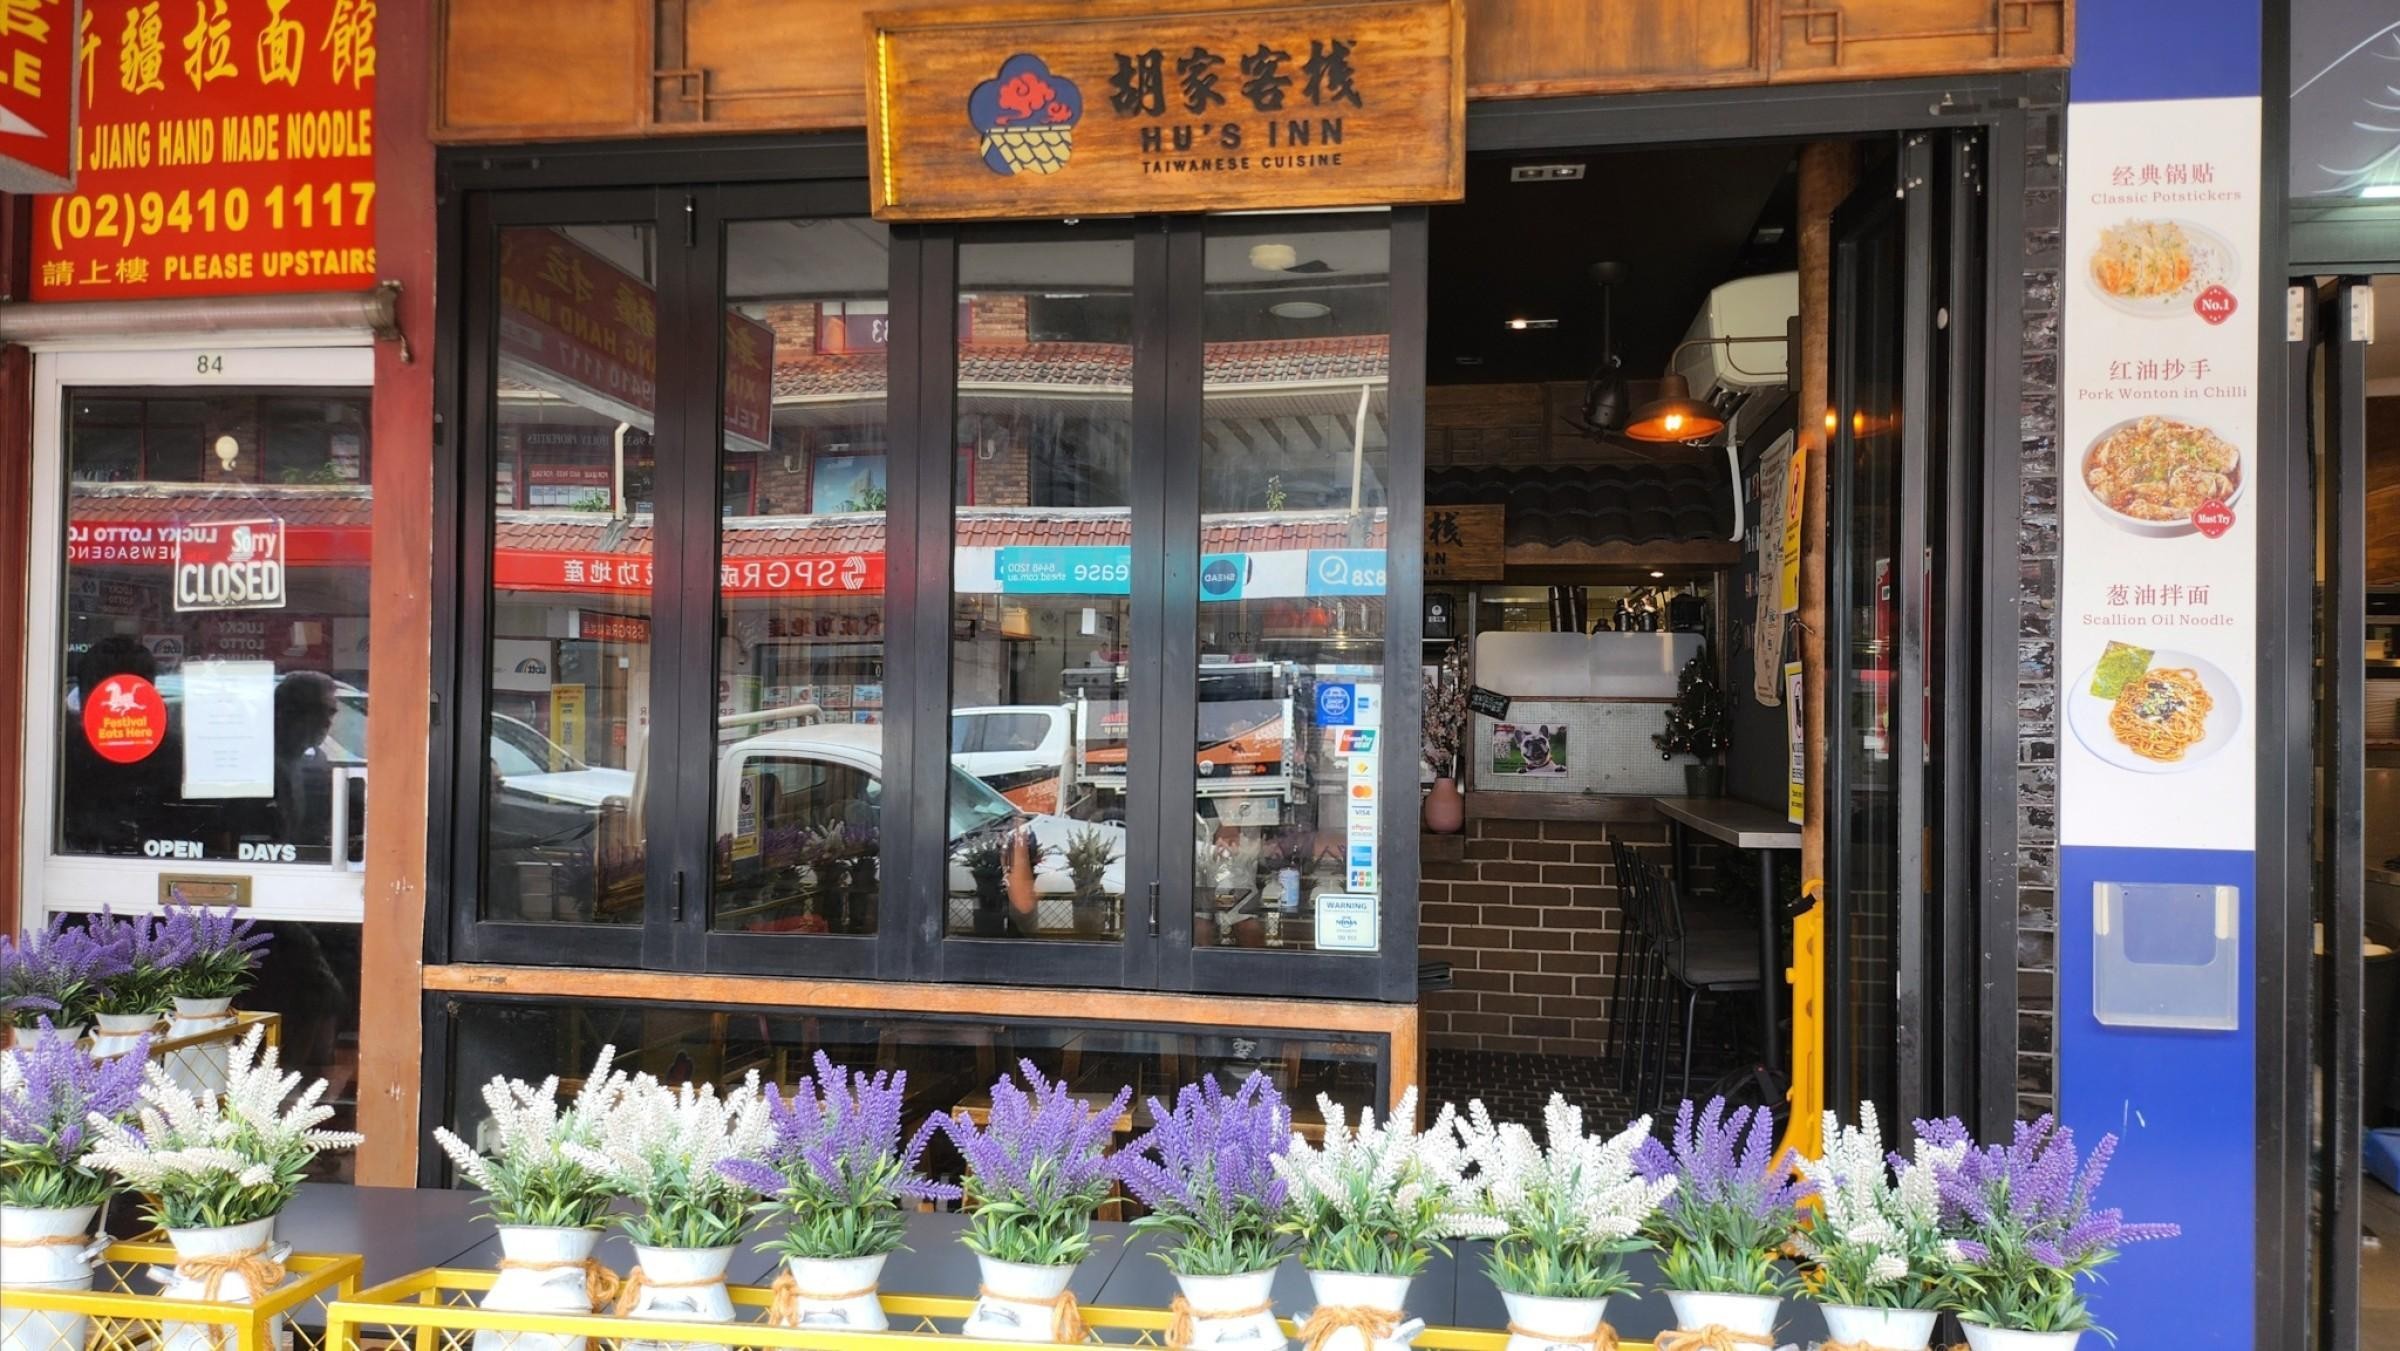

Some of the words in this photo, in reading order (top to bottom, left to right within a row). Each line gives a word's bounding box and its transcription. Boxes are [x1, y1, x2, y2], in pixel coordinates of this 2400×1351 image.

[2, 49, 41, 97] E
[1109, 39, 1364, 118] 胡家客栈
[91, 121, 150, 171] JIANG
[159, 117, 214, 166] HAND
[222, 114, 279, 162] MADE
[287, 108, 371, 158] NOODLE
[1141, 123, 1241, 153] HU'S
[1269, 118, 1343, 147] INN
[1143, 156, 1249, 173] TAIWANESE
[1262, 153, 1343, 170] CUISINE
[2112, 162, 2215, 186] 经典锅贴
[2091, 192, 2148, 204] Classic
[2153, 190, 2241, 203] Potstickers
[51, 187, 250, 250] (02)9410
[265, 181, 375, 230] 1117
[42, 257, 149, 286] 請上樓
[164, 253, 253, 280] PLEASE
[262, 248, 376, 278] UPSTAIRS
[2202, 299, 2230, 311] No.1
[197, 354, 223, 374] 84
[2109, 358, 2211, 381] 红油抄手
[2079, 388, 2112, 400] Pork
[2115, 387, 2178, 399] Wonton
[2184, 386, 2198, 398] in
[2204, 385, 2247, 398] Chilli
[231, 526, 277, 558] Sorry
[180, 560, 280, 603] CLOSED
[2106, 584, 2211, 606] 葱油拌面
[2082, 614, 2146, 626] Scallion
[2151, 614, 2174, 626] Oil
[2179, 614, 2235, 626] Noodle
[99, 727, 124, 738] Eats
[127, 727, 152, 738] Here
[104, 716, 147, 728] Festival
[144, 839, 204, 858] OPEN
[238, 843, 296, 862] DAYS
[1327, 902, 1367, 910] WARNING
